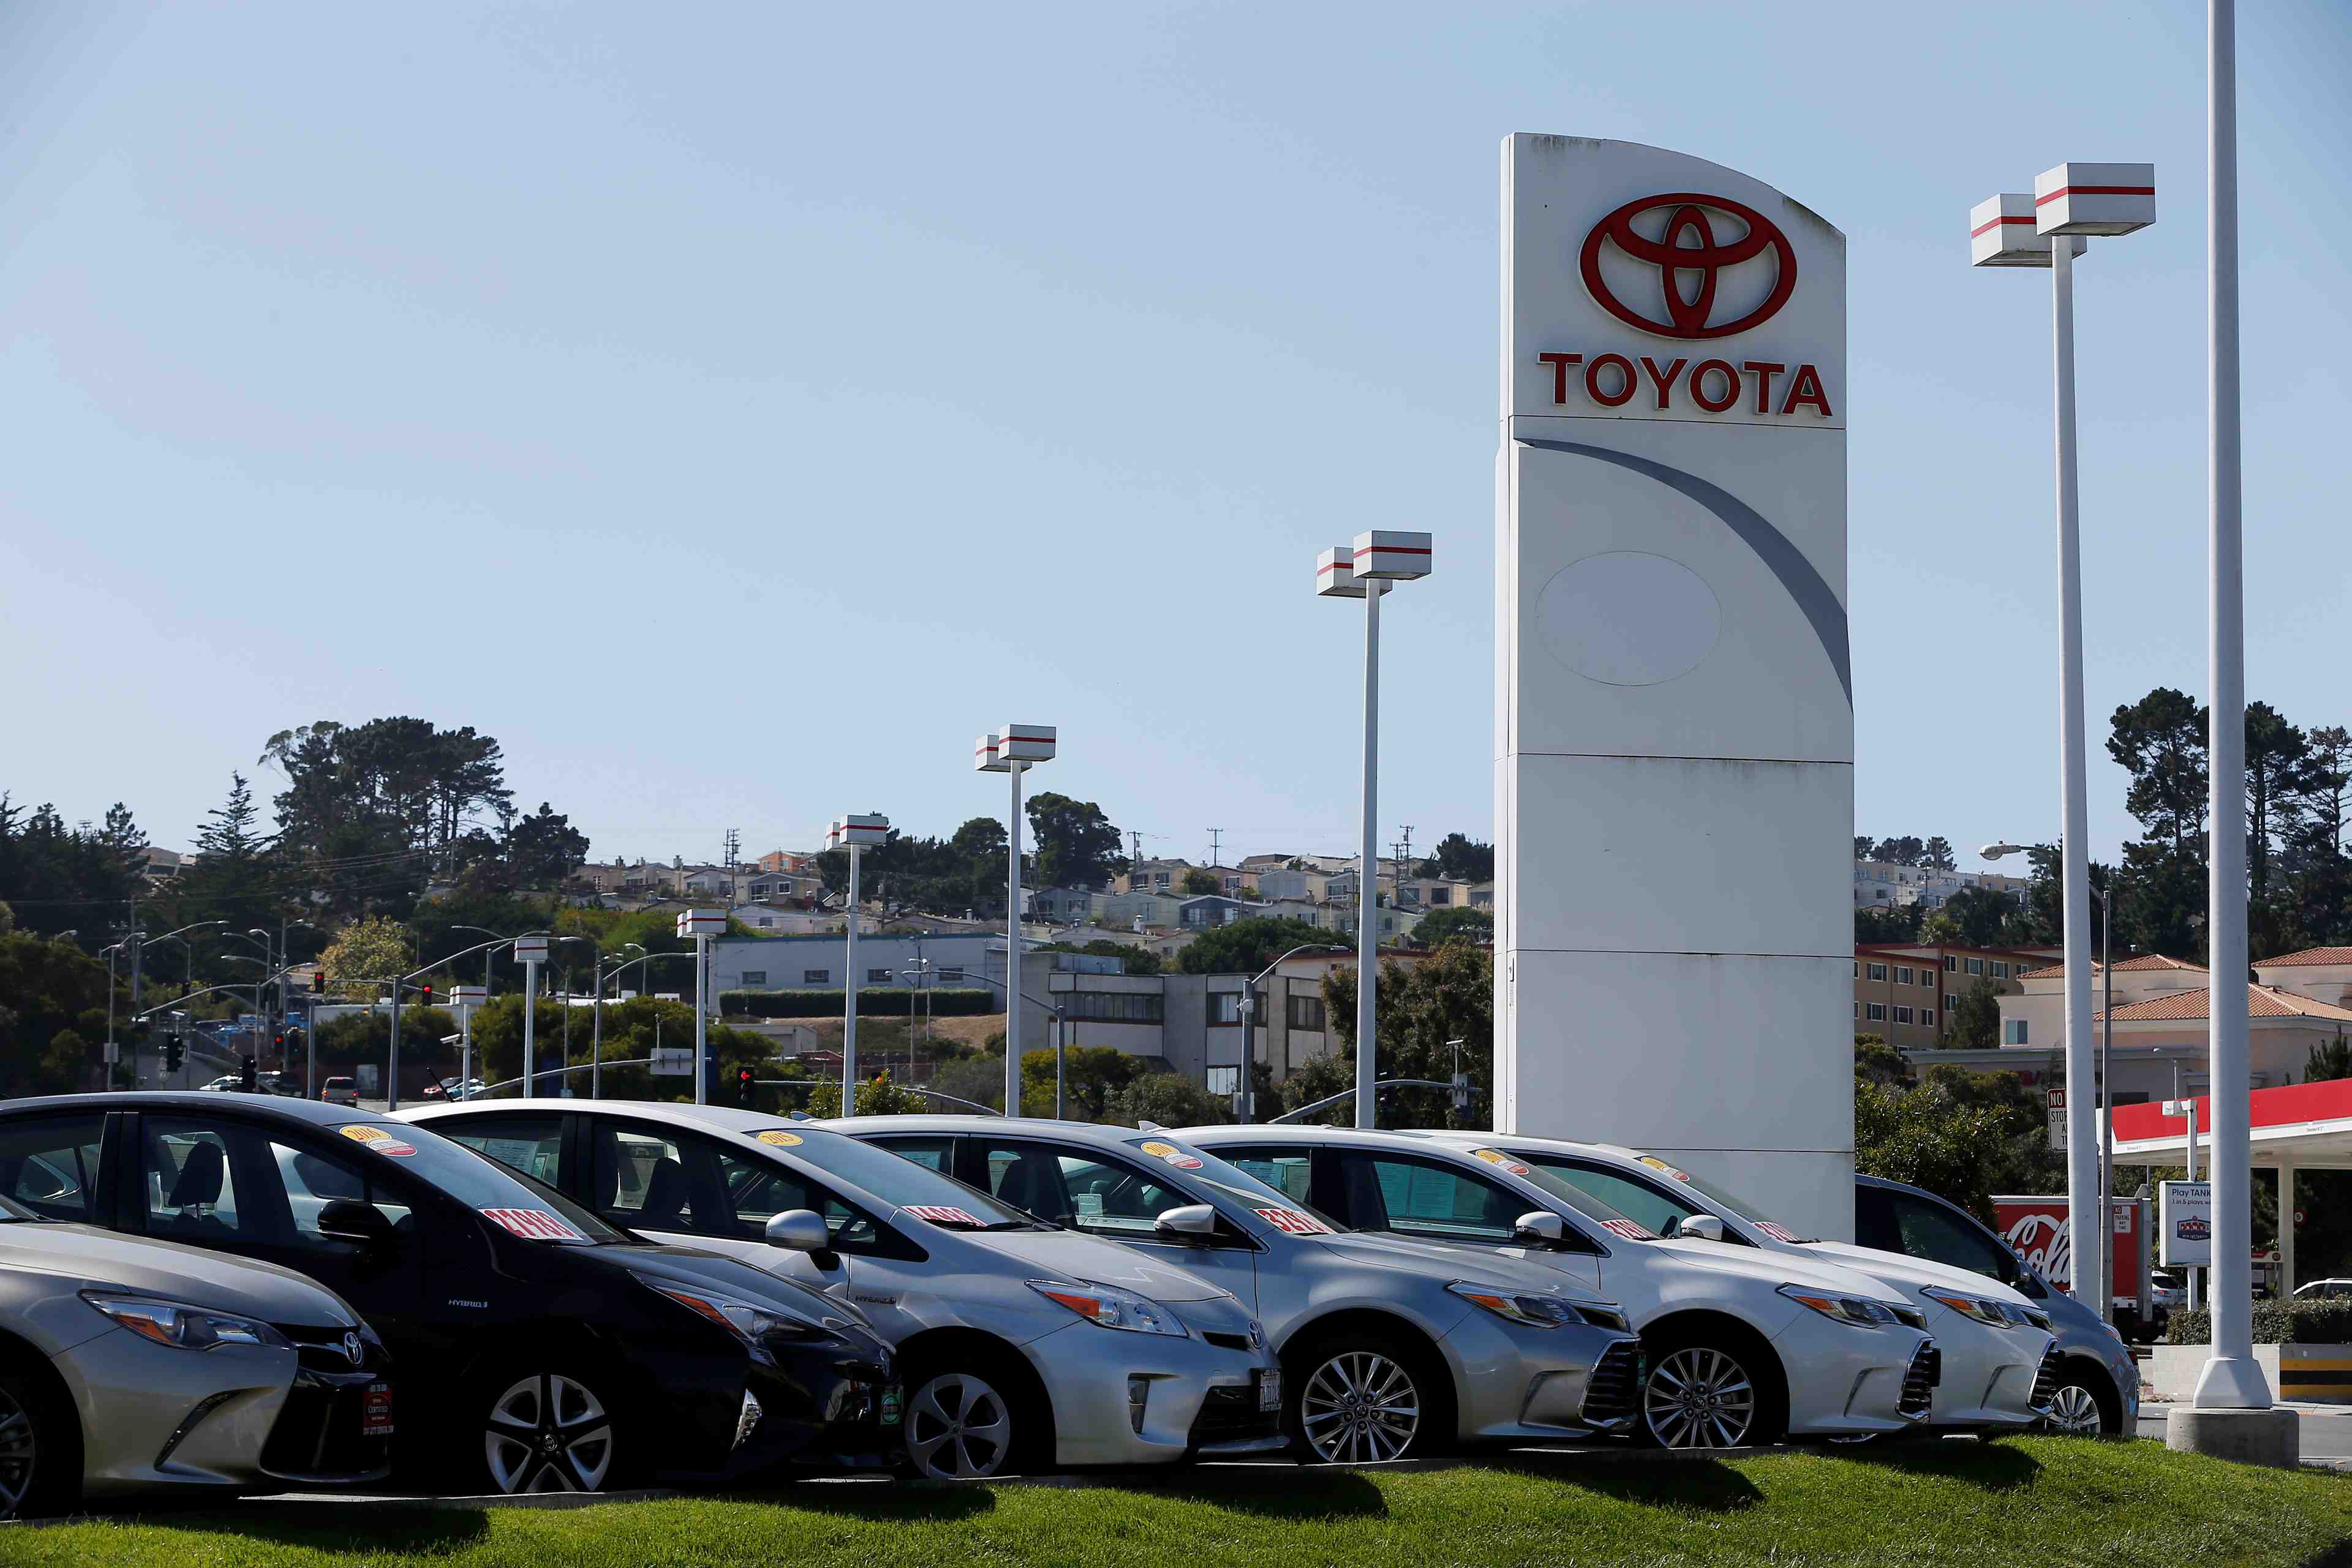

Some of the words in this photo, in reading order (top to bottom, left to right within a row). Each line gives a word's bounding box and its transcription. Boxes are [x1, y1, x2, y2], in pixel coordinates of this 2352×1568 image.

[1537, 352, 1833, 417] TOYOTA
[2050, 1092, 2062, 1106] NO
[2172, 1188, 2188, 1197] Play
[483, 1209, 576, 1238] 27988
